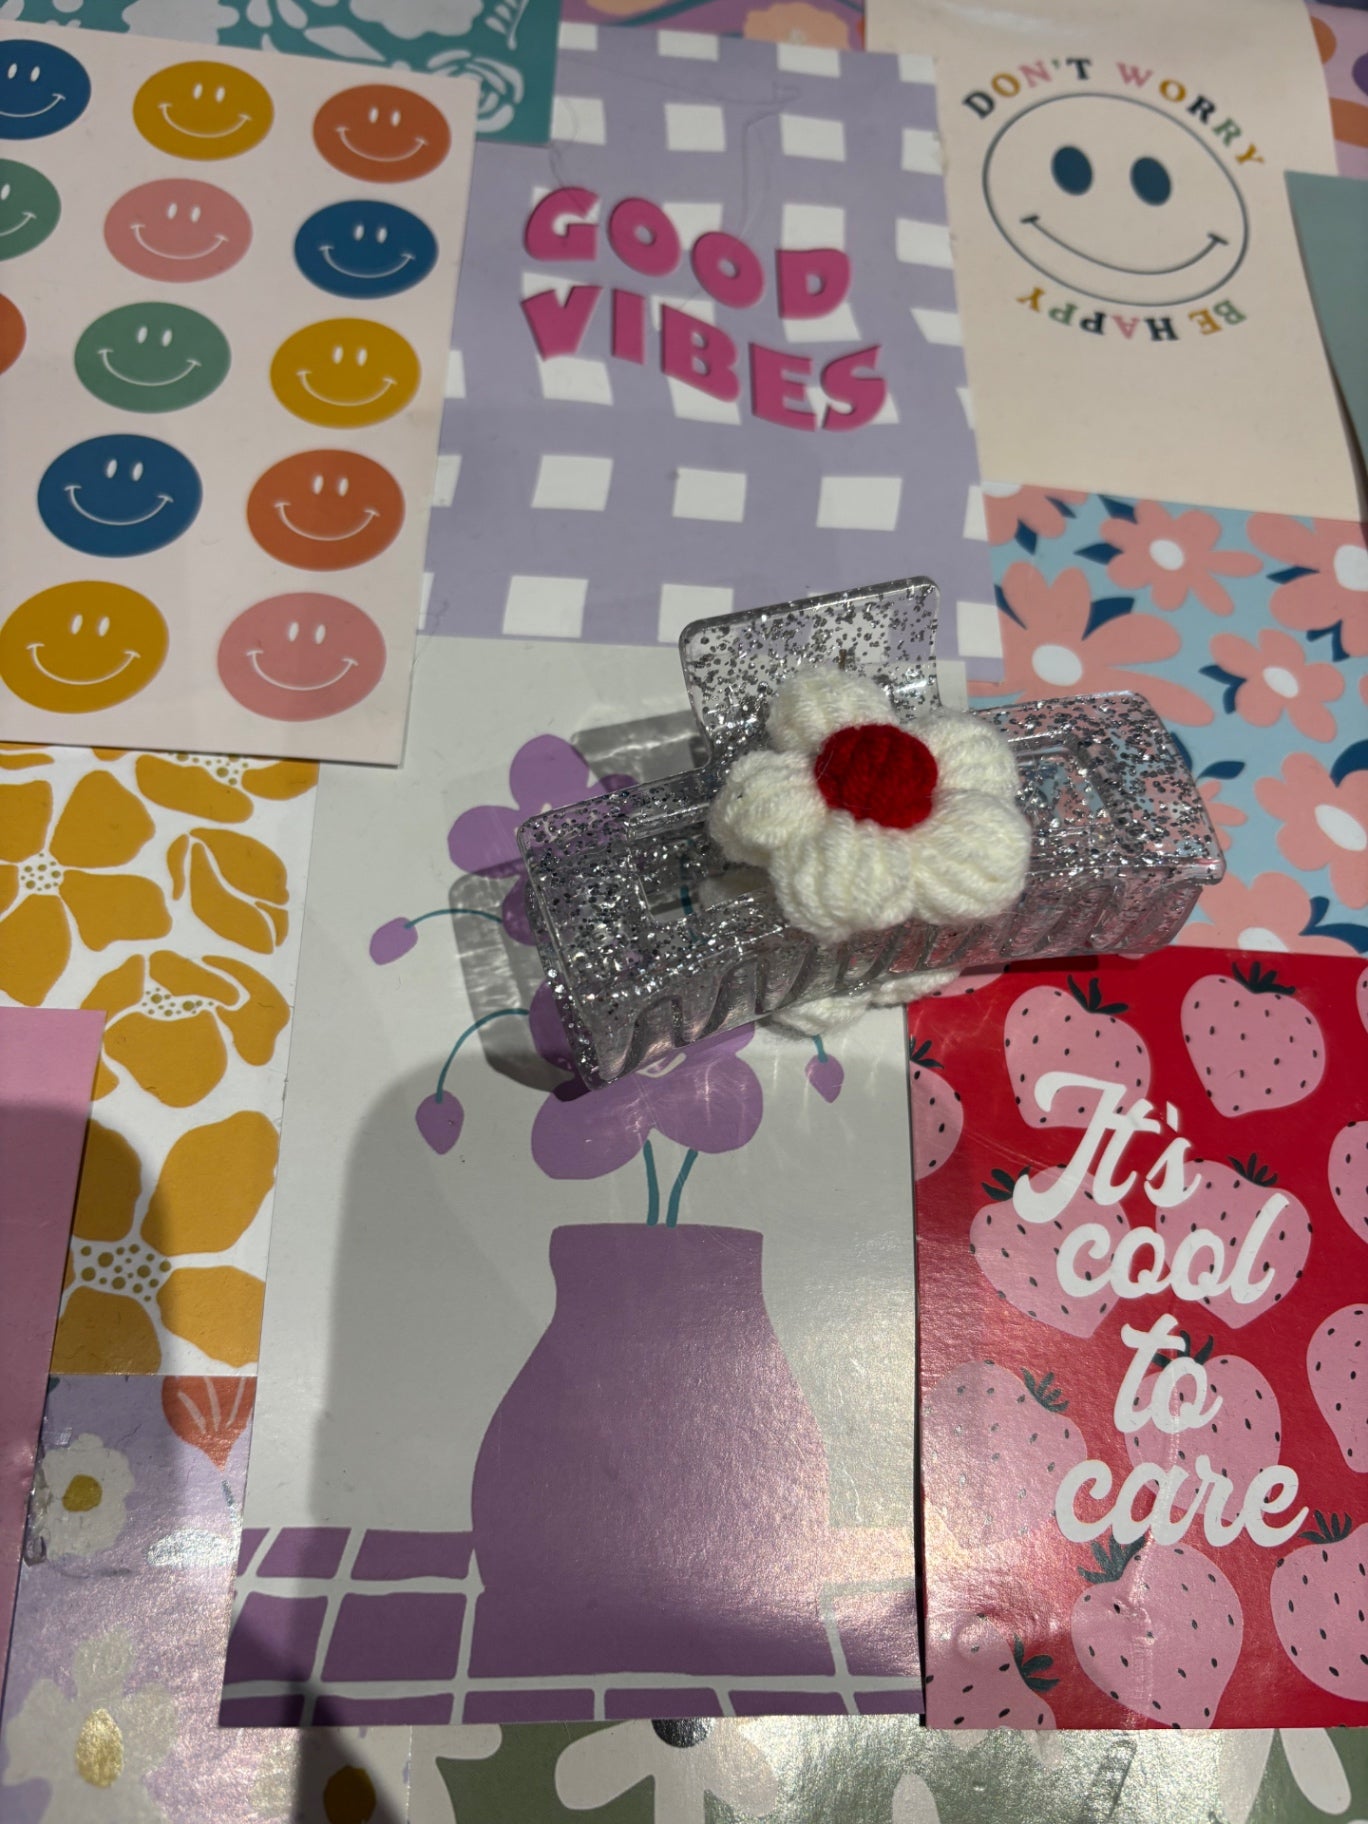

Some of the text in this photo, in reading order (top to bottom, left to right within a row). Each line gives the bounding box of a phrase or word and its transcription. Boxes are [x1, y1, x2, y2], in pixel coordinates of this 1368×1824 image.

[962, 57, 1264, 165] DON'T WORRY
[523, 186, 852, 320] GOOD
[520, 285, 887, 433] VIBES
[1016, 286, 1247, 342] BE HAPPY
[1012, 1071, 1202, 1224] It's
[1056, 1192, 1290, 1304] cool
[1113, 1313, 1223, 1434] to
[1054, 1455, 1309, 1548] care
